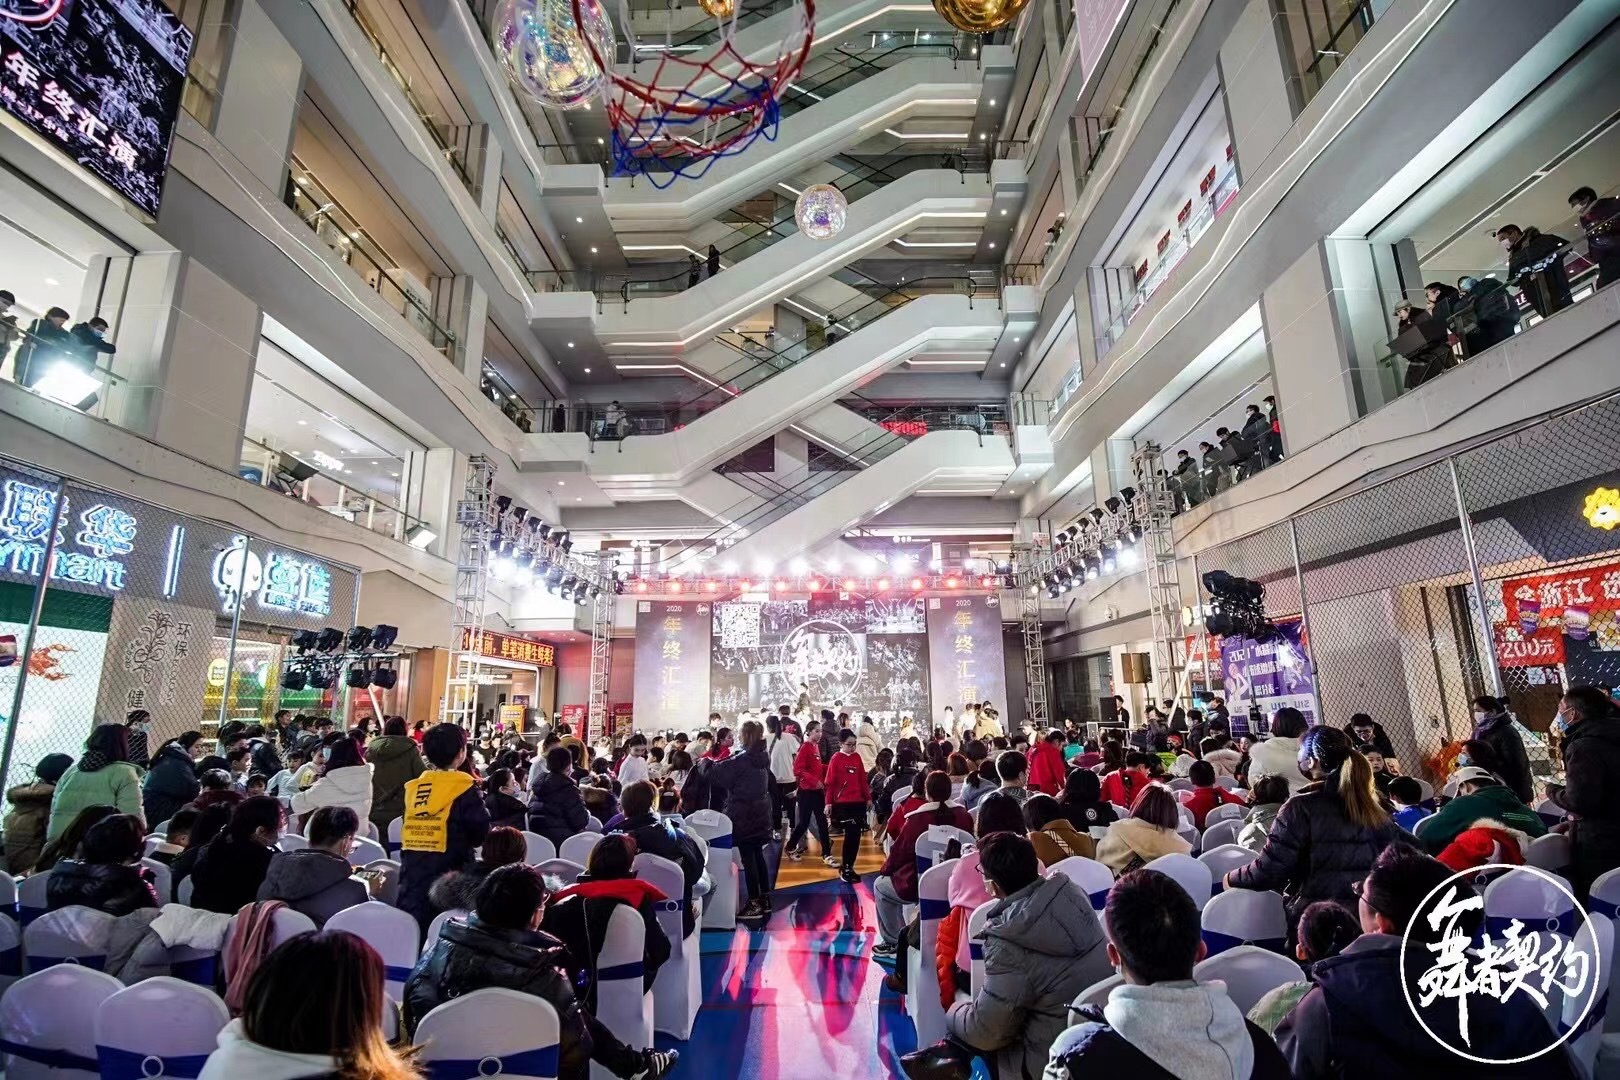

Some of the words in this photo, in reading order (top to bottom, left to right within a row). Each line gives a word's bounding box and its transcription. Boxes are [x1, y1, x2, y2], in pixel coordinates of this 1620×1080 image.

[4, 50, 140, 172] 年终汇演
[1, 480, 137, 558] 联华
[666, 605, 683, 613] 2020
[955, 599, 972, 607] 2020
[175, 622, 192, 657] 环保
[954, 611, 977, 703] 年终汇演
[414, 783, 433, 808] LIFE
